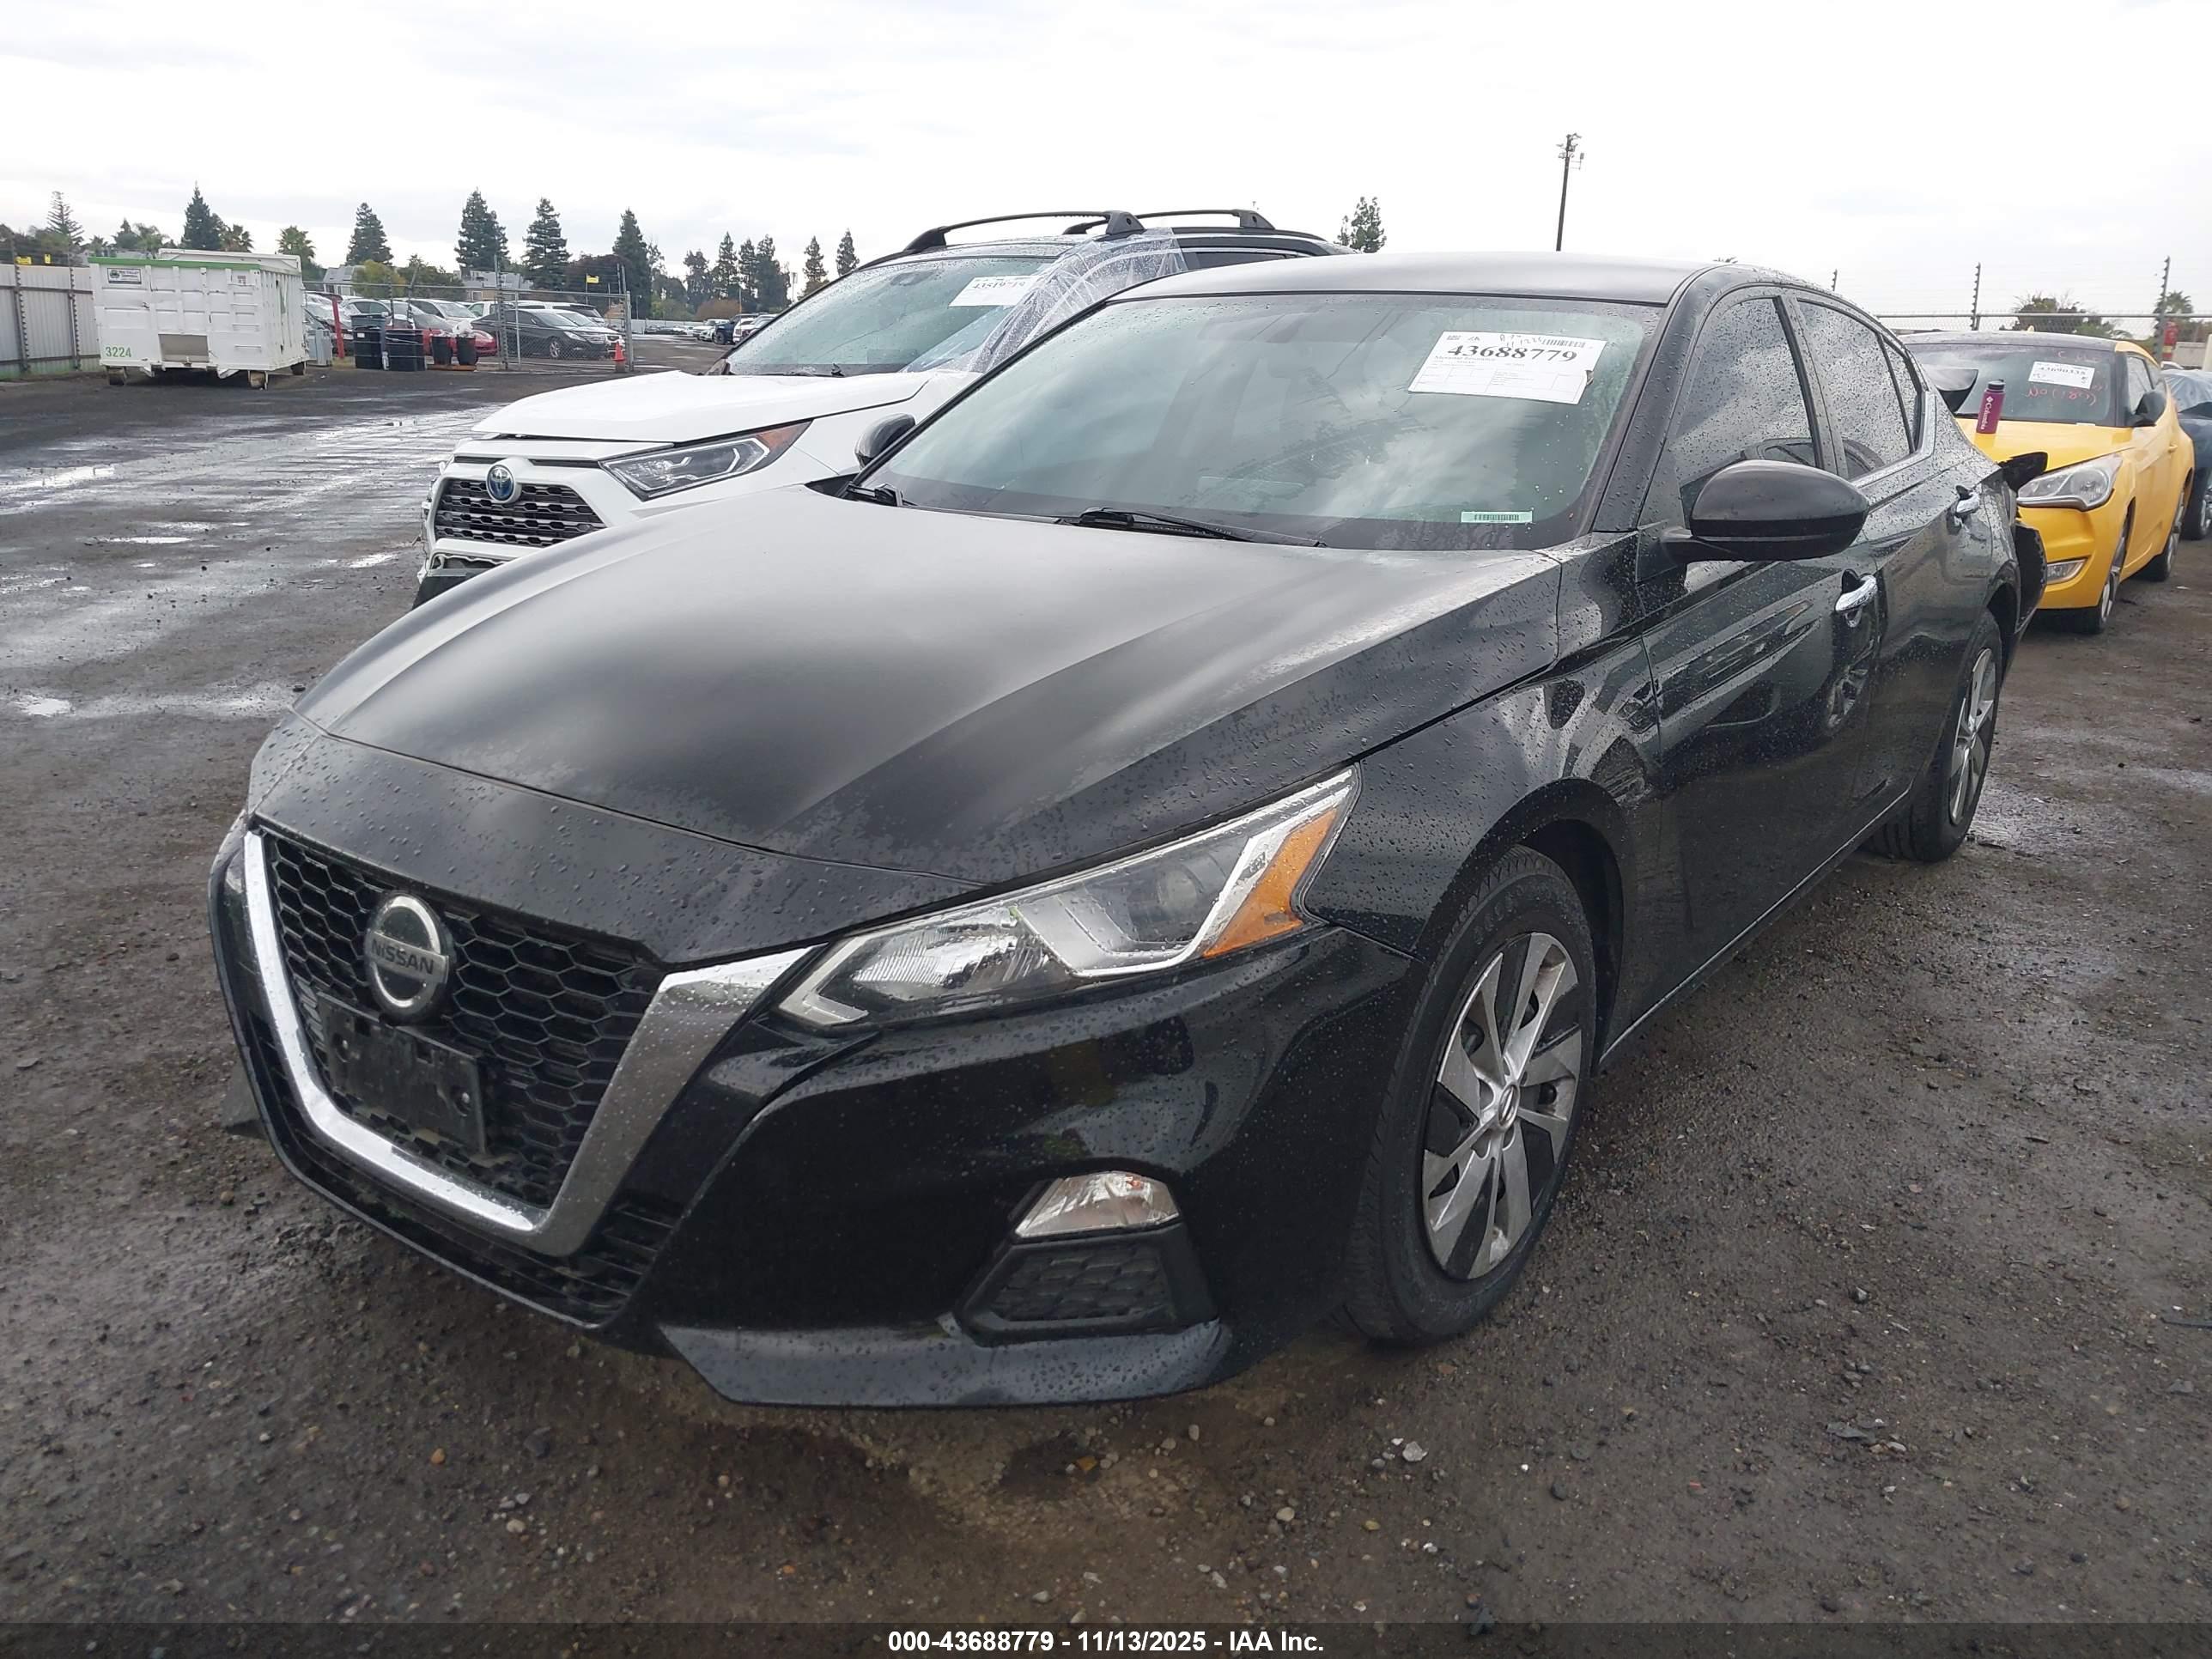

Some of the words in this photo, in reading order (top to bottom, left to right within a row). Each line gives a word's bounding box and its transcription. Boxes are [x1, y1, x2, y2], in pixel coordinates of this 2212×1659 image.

[106, 346, 131, 358] 3224
[1447, 344, 1577, 362] 43688779
[1980, 403, 1992, 430] Columbia
[371, 939, 434, 975] NISSAN
